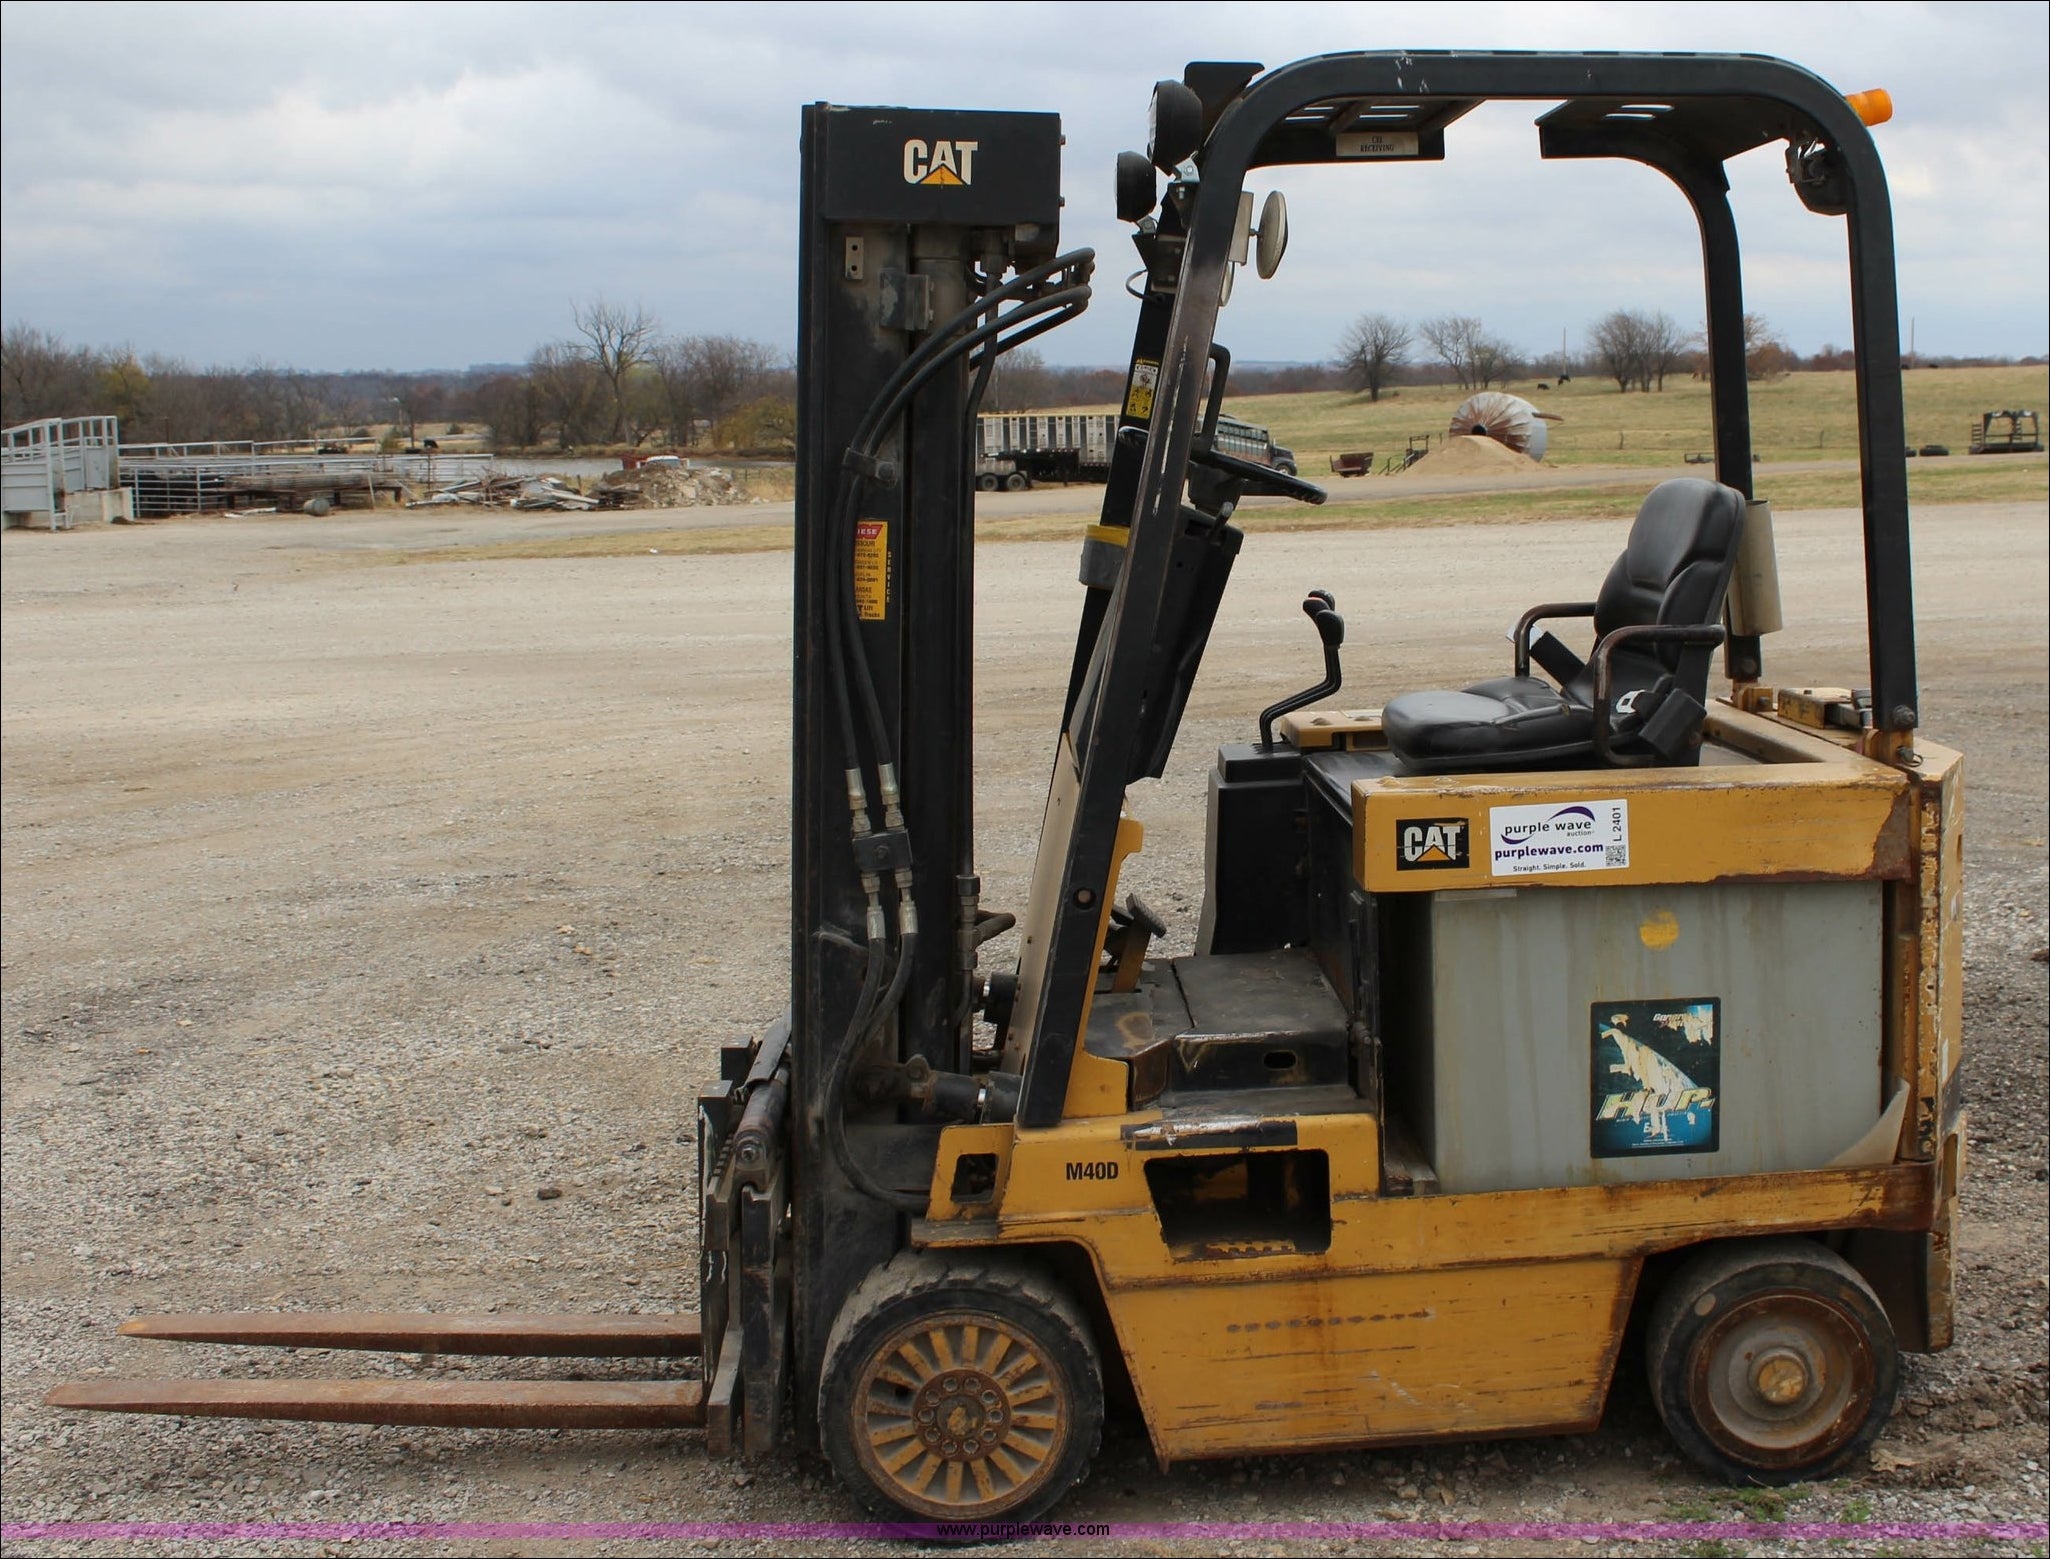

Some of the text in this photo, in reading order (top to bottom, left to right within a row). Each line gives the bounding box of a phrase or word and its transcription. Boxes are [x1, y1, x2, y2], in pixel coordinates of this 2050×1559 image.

[903, 138, 978, 185] CAT
[1505, 820, 1592, 836] purple wave
[1612, 807, 1622, 842] L 2401
[1404, 825, 1460, 862] CAT
[1494, 843, 1604, 861] purplewave.com
[1513, 861, 1587, 873] Straight. Simple. Sold.
[1066, 1161, 1119, 1181] M40D
